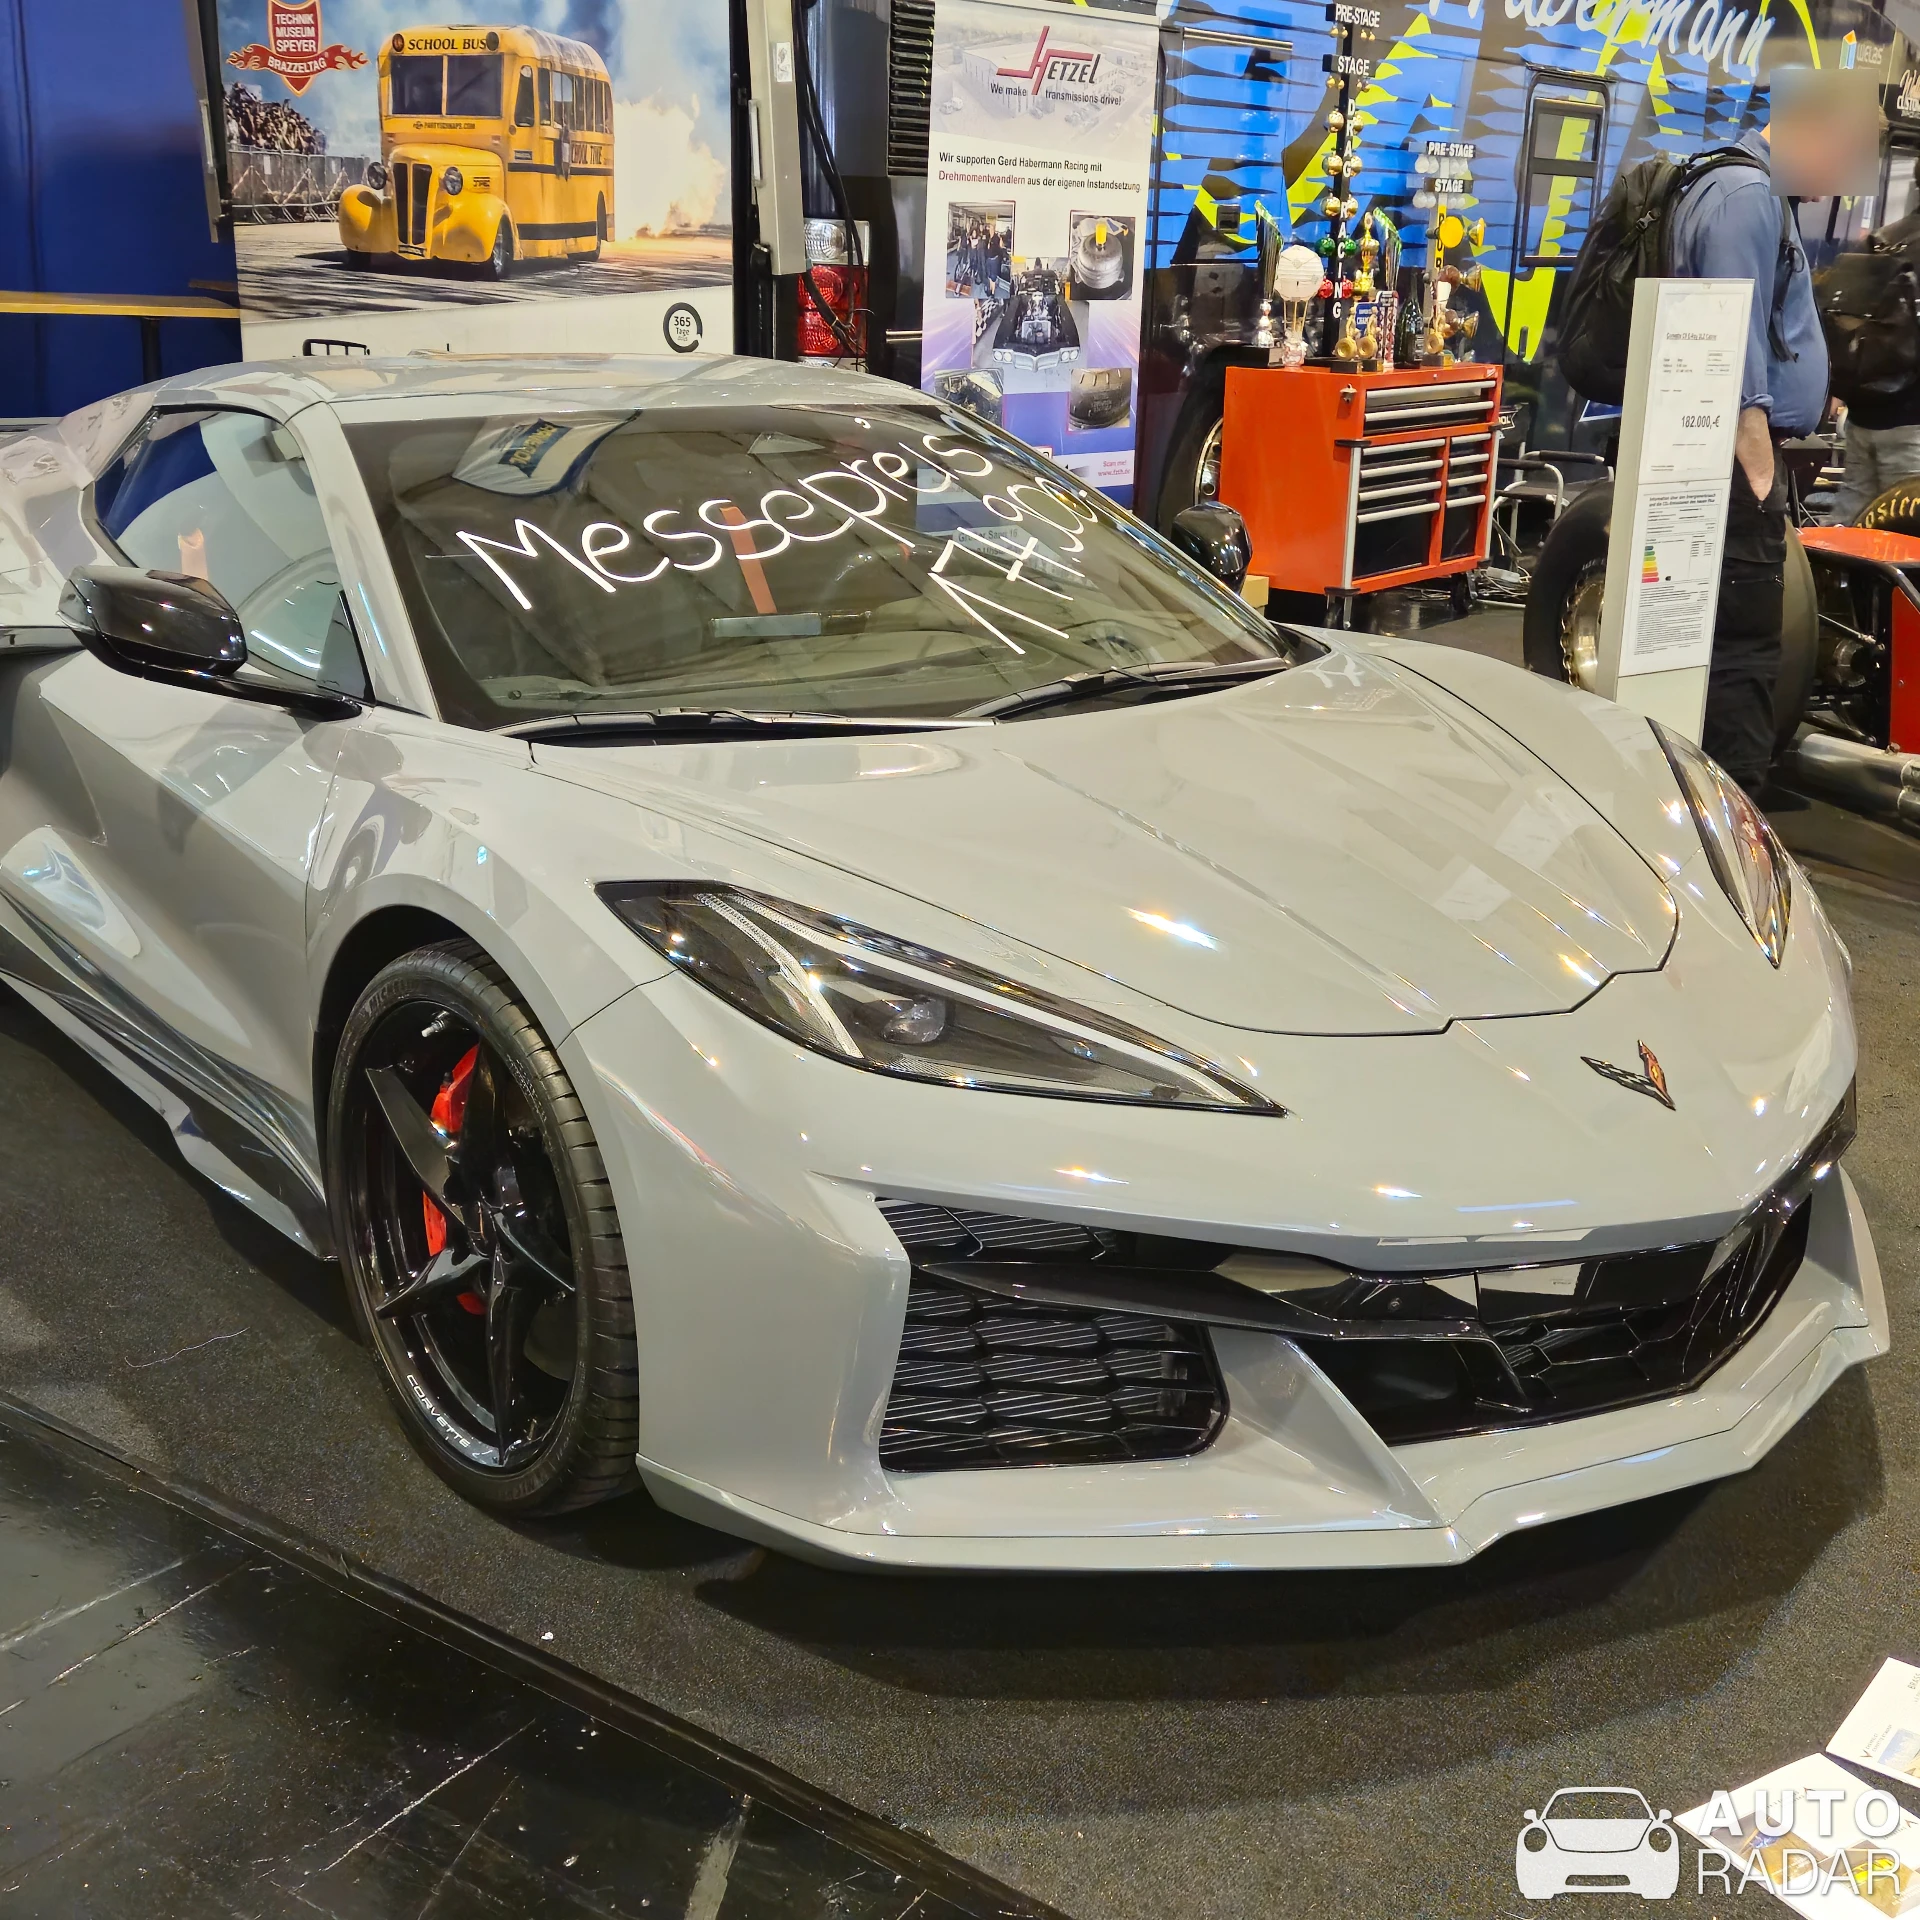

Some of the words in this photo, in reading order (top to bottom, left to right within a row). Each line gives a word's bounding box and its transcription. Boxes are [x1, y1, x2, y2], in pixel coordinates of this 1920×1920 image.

[275, 13, 314, 25] TECHNIK
[1335, 3, 1381, 28] PRE-STAGE
[275, 26, 316, 38] MUSEUM
[276, 40, 317, 52] SPEYER
[408, 38, 458, 50] SCHOOL
[462, 38, 487, 50] BUS
[267, 56, 328, 73] BRAZZELTAG
[1337, 55, 1370, 76] STAGE
[990, 82, 1004, 94] We
[1005, 84, 1027, 97] make
[1045, 89, 1099, 104] transmissions
[1100, 93, 1122, 106] drive!
[1342, 98, 1356, 178] DRAG
[1428, 141, 1474, 158] PRE-STAGE
[939, 152, 955, 163] Wir
[956, 155, 996, 167] supporten
[997, 155, 1018, 167] Gerd
[1019, 157, 1062, 170] Habermann
[1064, 160, 1089, 173] Racing
[1090, 161, 1103, 172] mit
[938, 170, 1026, 185] Drehmomentwandlern
[1027, 176, 1041, 186] aus
[1042, 176, 1056, 187] der
[1057, 178, 1085, 190] eigenen
[1086, 180, 1141, 193] Instandsetzung.
[1434, 179, 1464, 193] STAGE
[1332, 201, 1348, 319] RACING
[674, 316, 691, 327] 365
[676, 327, 690, 336] Tage
[1681, 415, 1721, 430] 182.000,-€
[456, 417, 993, 610] Messepreis
[407, 1374, 471, 1448] CORVETTE
